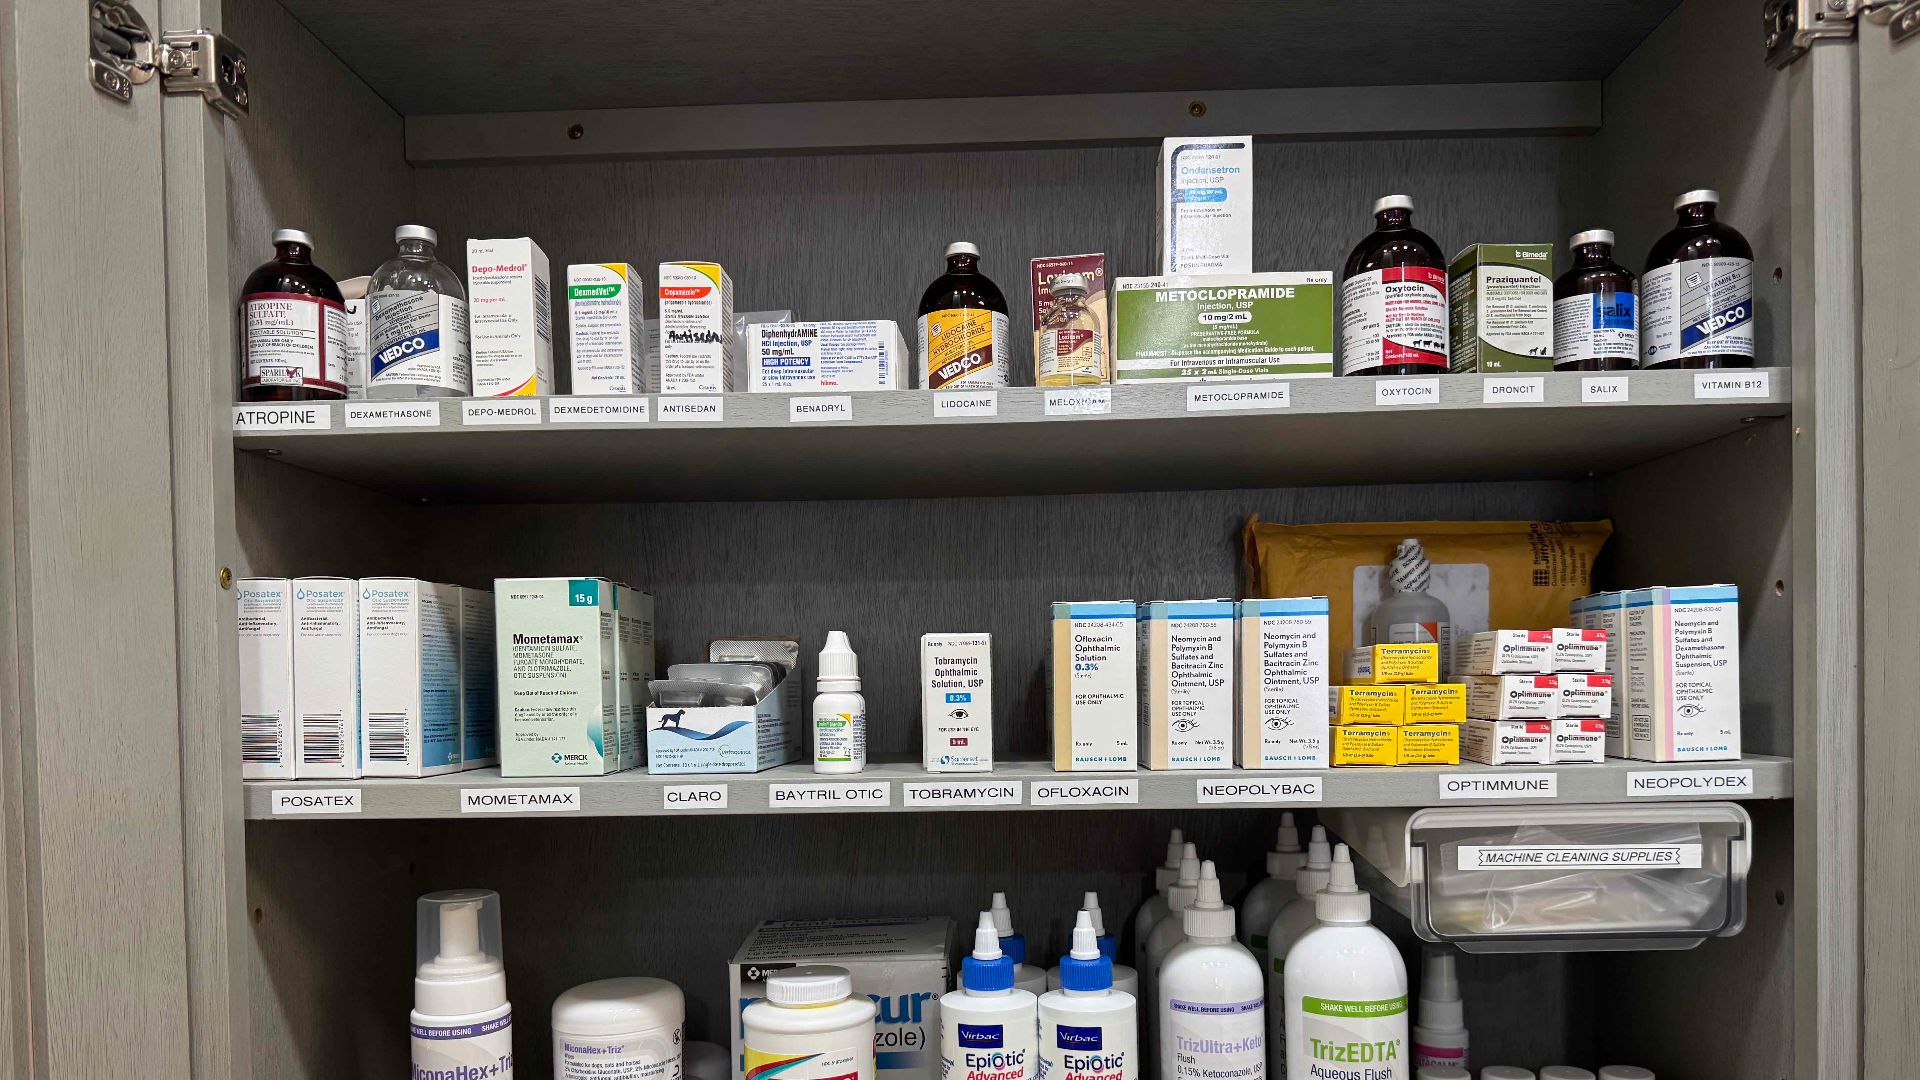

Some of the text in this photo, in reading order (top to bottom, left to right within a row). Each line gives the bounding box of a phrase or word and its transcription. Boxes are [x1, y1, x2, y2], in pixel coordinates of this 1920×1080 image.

[1181, 166, 1240, 175] Ondansetron
[1486, 276, 1541, 284] Praziquantel
[1385, 285, 1425, 294] Oxytocin
[1155, 288, 1295, 302] METOCLOPRAMIDE
[1696, 306, 1745, 335] VEDCO
[761, 329, 817, 339] DiphenhydrAMINE
[378, 338, 425, 364] VEDCO
[1225, 357, 1268, 365] Intramuscular
[937, 353, 982, 380] VEDCO
[1492, 386, 1535, 394] DRONCIT
[1590, 385, 1618, 394] SALIX
[1702, 381, 1741, 390] VITAMIN
[1381, 387, 1432, 396] OXYTOCIN
[1194, 392, 1284, 402] METOCLOPRAMIDE
[941, 400, 992, 408] LIDOCAINE
[468, 408, 536, 416] DEPO-MEDROL
[554, 405, 645, 414] DEXMEDETOMIDINE
[663, 405, 716, 413] ANTISEDAN
[236, 410, 315, 424] ATROPINE
[350, 410, 431, 418] DEXAMETHASONE
[243, 590, 281, 598] Posatex
[306, 590, 344, 598] Posatex
[371, 590, 409, 598] Posatex
[575, 594, 592, 604] 15 g
[1074, 635, 1112, 643] Ofloxacin
[1171, 635, 1207, 643] Neomycin
[1075, 644, 1121, 652] Ophthalmic
[1171, 644, 1207, 652] Polymyxin
[1263, 641, 1300, 650] Polymyxin
[934, 657, 978, 666] Tobramycin
[1075, 654, 1106, 662] Solution
[1075, 663, 1098, 671] 0.3%
[1171, 662, 1207, 670] Bacitracin
[1263, 659, 1300, 667] Bacitracin
[935, 668, 977, 677] Ophthalmic
[1171, 671, 1212, 679] Ophthalmic
[1263, 669, 1307, 677] Ophthalmic
[931, 680, 965, 688] Solution,
[1171, 680, 1207, 688] Ointment,
[1263, 677, 1301, 685] Ointment,
[1447, 780, 1549, 792] OPTIMMUNE
[1634, 776, 1747, 788] NEOPOLYDEX
[775, 789, 883, 800] BAYTRIL OTIC
[909, 788, 1014, 799] TOBRAMYCIN
[1038, 786, 1129, 798] OFLOXACIN
[1203, 784, 1315, 796] NEOPOLYBAC
[468, 794, 573, 805] MOMETAMAX
[667, 791, 722, 802] CLARO
[281, 796, 354, 807] POSATEX
[1485, 851, 1672, 863] MACHINE CLEANING SUPPLIES
[1320, 1003, 1343, 1011] SHAKE
[1344, 1005, 1363, 1013] WELL
[482, 1022, 499, 1032] SHAKE
[961, 1031, 999, 1040] Virbac
[1060, 1032, 1098, 1042] Virbac
[1177, 1053, 1196, 1064] Flush
[967, 1067, 1024, 1080] Advanced
[1178, 1066, 1200, 1077] 0.15%
[1311, 1064, 1392, 1080] Aqueous Flush
